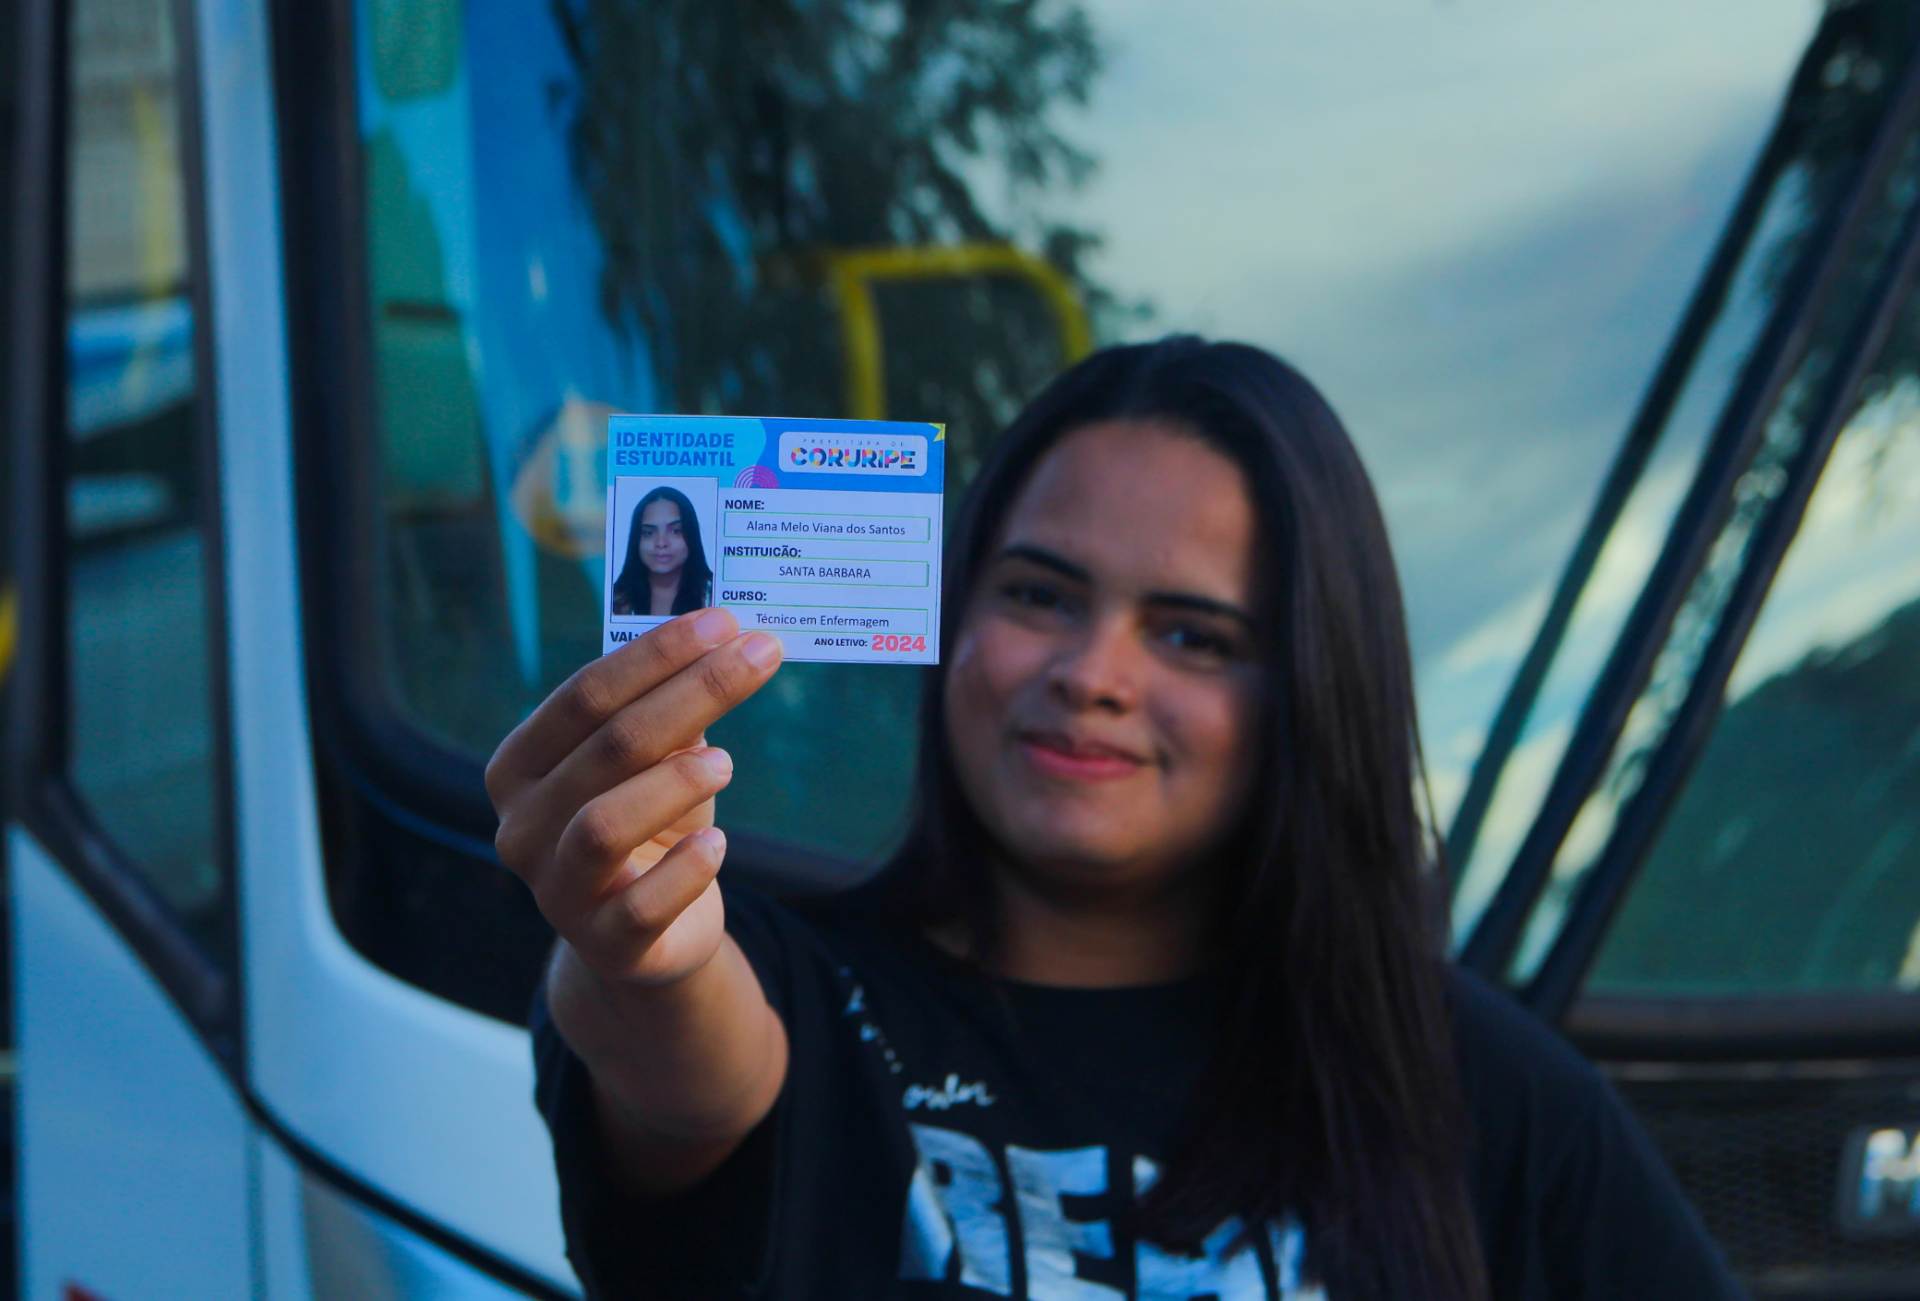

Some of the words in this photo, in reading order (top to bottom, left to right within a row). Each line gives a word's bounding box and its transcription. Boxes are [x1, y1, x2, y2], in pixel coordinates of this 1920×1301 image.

[616, 431, 735, 448] IDENTIDADE
[616, 451, 735, 467] ESTUDANTIL
[791, 447, 916, 469] CORURIPE
[725, 499, 765, 510] NOME:
[746, 520, 778, 532] Alana
[781, 521, 809, 533] Melo
[812, 522, 843, 534] Viana
[846, 523, 866, 534] dos
[869, 524, 906, 536] Santos
[779, 566, 816, 577] SANTA
[819, 567, 871, 579] BARBARA
[722, 590, 767, 602] CURSO:
[756, 613, 797, 625] Técnico
[800, 616, 817, 625] em
[820, 615, 890, 629] Enfermagem
[814, 637, 834, 647] ANO
[836, 638, 868, 647] LETIVO:
[871, 634, 927, 653] 2024
